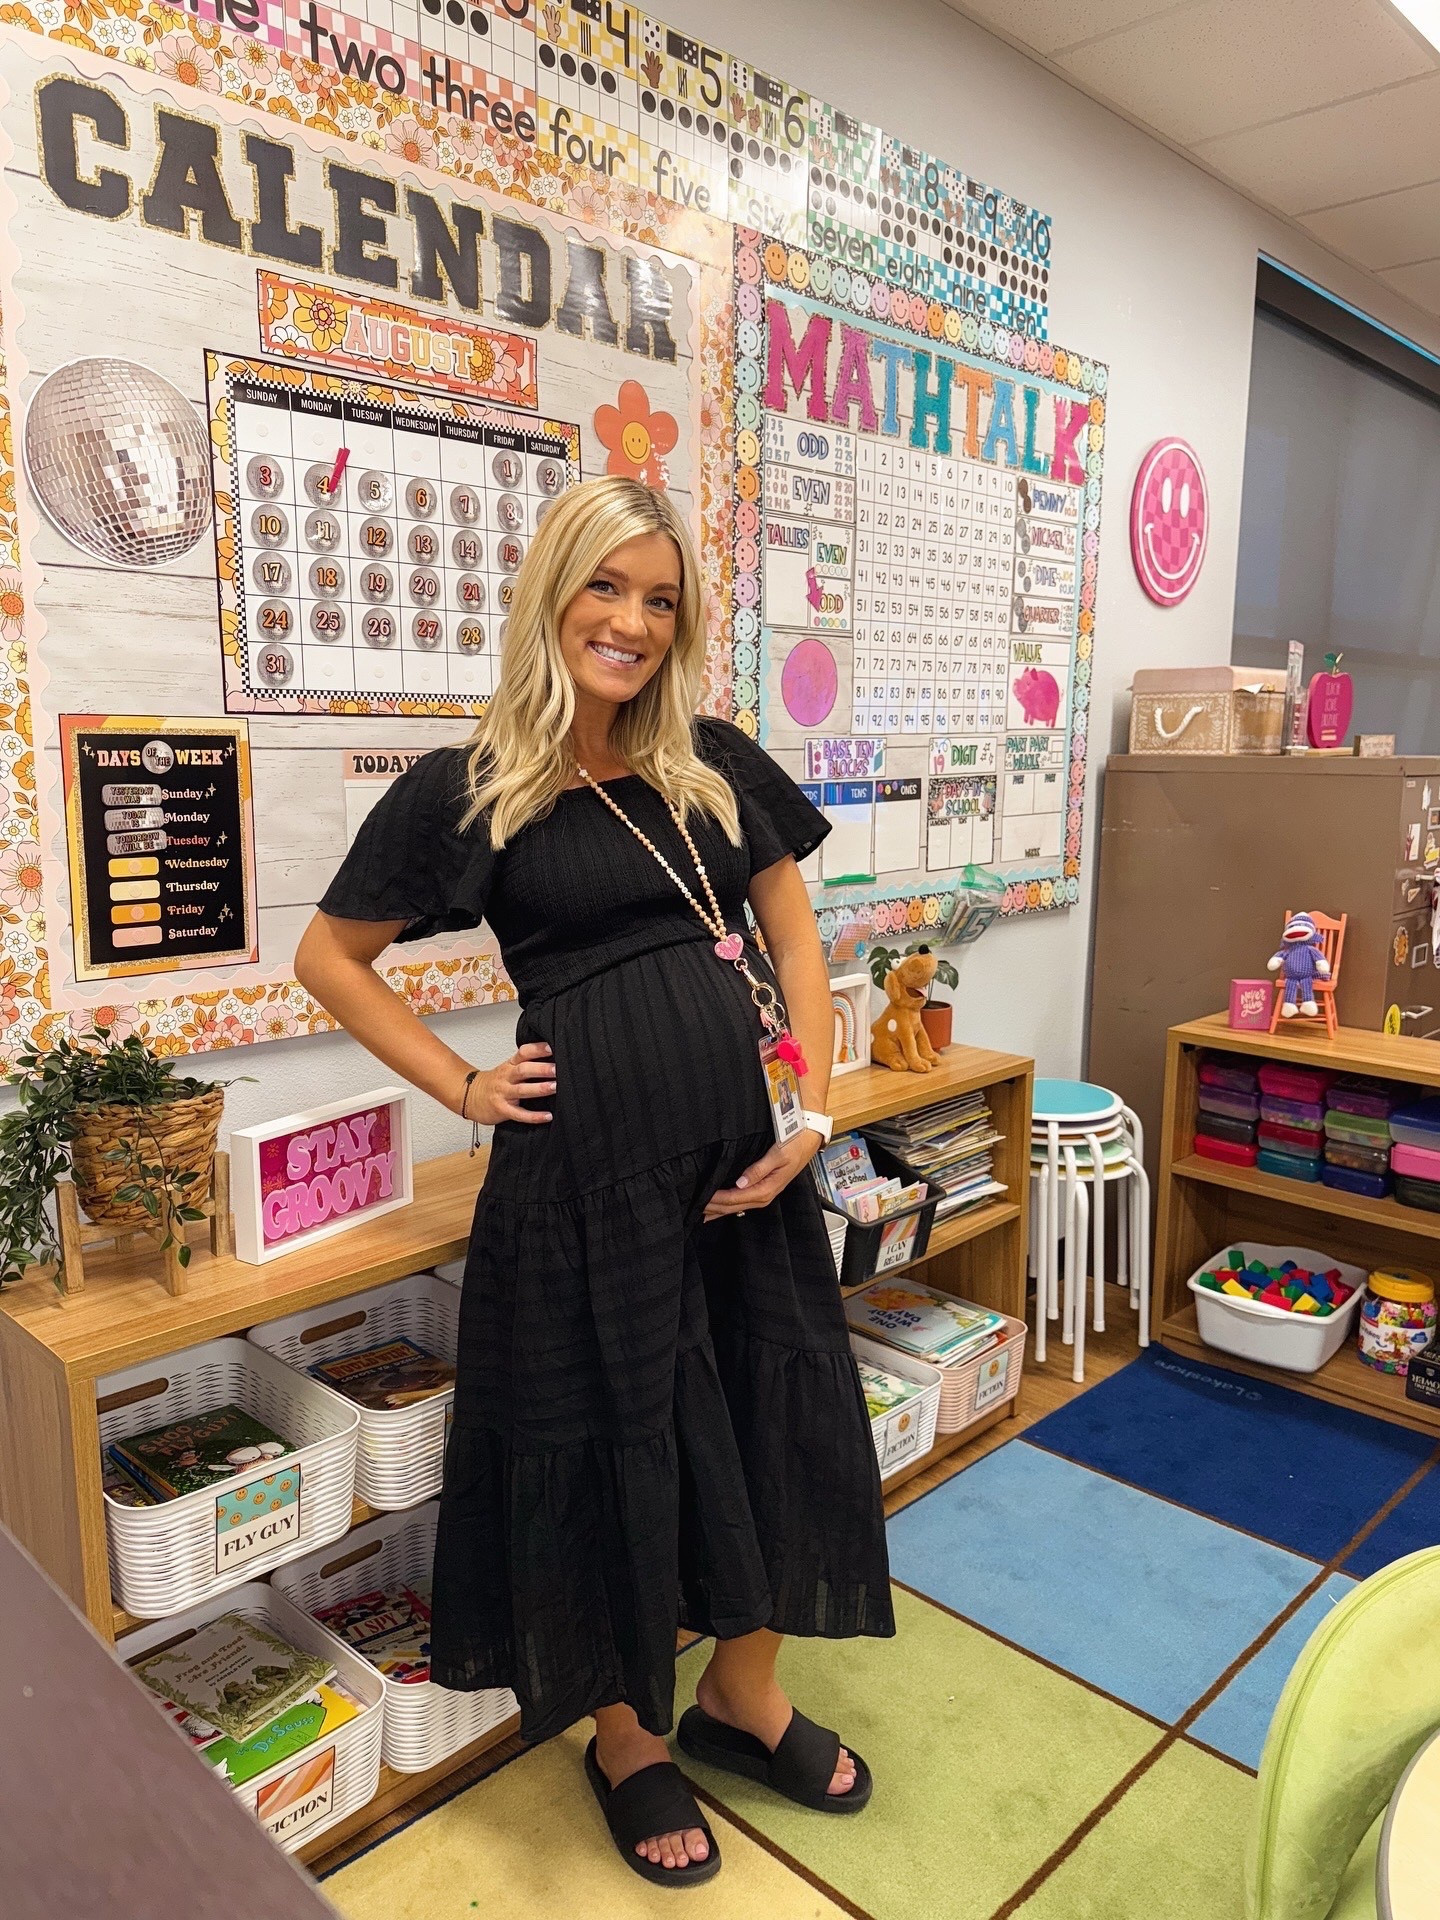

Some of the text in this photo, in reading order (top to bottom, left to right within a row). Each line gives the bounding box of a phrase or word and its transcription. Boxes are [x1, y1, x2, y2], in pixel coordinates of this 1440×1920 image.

[606, 1, 630, 68] 4
[300, 2, 405, 95] two
[700, 53, 722, 108] 5
[423, 56, 535, 142] three
[783, 96, 805, 148] 6
[549, 107, 626, 177] four
[860, 130, 881, 181] 7
[653, 150, 711, 213] five
[925, 163, 939, 210] 8
[34, 72, 679, 366] CALENDAR
[747, 198, 786, 237] six
[984, 193, 998, 238] 9
[811, 220, 874, 269] seven
[1030, 214, 1051, 260] 10
[887, 254, 933, 293] eight
[952, 279, 986, 315] nine
[1008, 296, 1036, 336] ten
[343, 311, 473, 378] AUGUST
[246, 389, 562, 455] SUNDAY MONDAY TUESDAY WEDNESDAY THURSDAY FRIDAY SATURDAY
[797, 432, 829, 460] ODD
[503, 459, 556, 486] 1 2
[259, 465, 516, 520] 3 4 5 6 7 8
[793, 475, 831, 505] EVEN
[861, 479, 1012, 519] 11 12 13 14 15 16 17 18 19 20
[1033, 488, 1067, 513] PENNY
[259, 515, 519, 563] 10 11 12 13 14 15
[766, 523, 810, 549] TALLIES
[1031, 526, 1064, 551] NICKEL
[816, 543, 847, 565] EVEN
[261, 562, 515, 604] 17 18 19 20 21 2
[1035, 564, 1057, 587] DIME
[819, 593, 844, 614] ODD
[1024, 605, 1060, 624] QUARTER
[263, 609, 481, 646] 24 25 26 27 28
[266, 654, 286, 674] 31
[1013, 643, 1042, 663] VALUE
[855, 714, 930, 726] 91 92 93 94 95
[97, 747, 223, 767] DAYS OF THE WEEK
[823, 740, 875, 759] BASE TEN
[951, 745, 978, 766] DIGIT
[1006, 737, 1049, 753] PART PART
[828, 758, 869, 778] BLOCKS
[934, 755, 945, 774] 19
[1013, 754, 1040, 770] WHOLE
[110, 787, 154, 796] YESTERDAY
[161, 788, 203, 800] Sunday
[851, 788, 867, 798] TENS
[900, 784, 917, 795] ONES
[944, 782, 981, 799] DAYS IN
[121, 810, 147, 819] TODAY
[163, 812, 210, 824] Monday
[945, 798, 980, 816] SCHOOL
[115, 832, 160, 844] TOMORROW
[166, 835, 211, 846] Tuesday
[165, 857, 230, 869] Wednesday
[166, 881, 220, 892] Thursday
[167, 904, 205, 916] Friday
[168, 926, 218, 940] Saturday
[287, 1112, 378, 1180] STAY
[848, 1173, 868, 1185] School
[263, 1150, 398, 1240] GROOVY
[890, 1240, 907, 1252] CAN
[883, 1252, 905, 1267] READ
[867, 1309, 912, 1327] WINDY
[868, 1315, 897, 1329] ONE
[895, 1310, 921, 1323] DAY
[979, 1380, 1004, 1399] FICTION
[138, 1425, 192, 1453] SHOO
[161, 1414, 240, 1457] FLY GUY!
[886, 1433, 915, 1457] FICTION
[224, 1514, 295, 1557] FLY GUY
[353, 1613, 398, 1639] I SPY
[174, 1662, 201, 1683] Frog
[201, 1650, 218, 1665] and
[218, 1635, 244, 1652] Toad
[188, 1667, 208, 1684] Are
[209, 1643, 247, 1671] Friends
[253, 1735, 278, 1754] Dr.
[271, 1715, 315, 1737] Seuss
